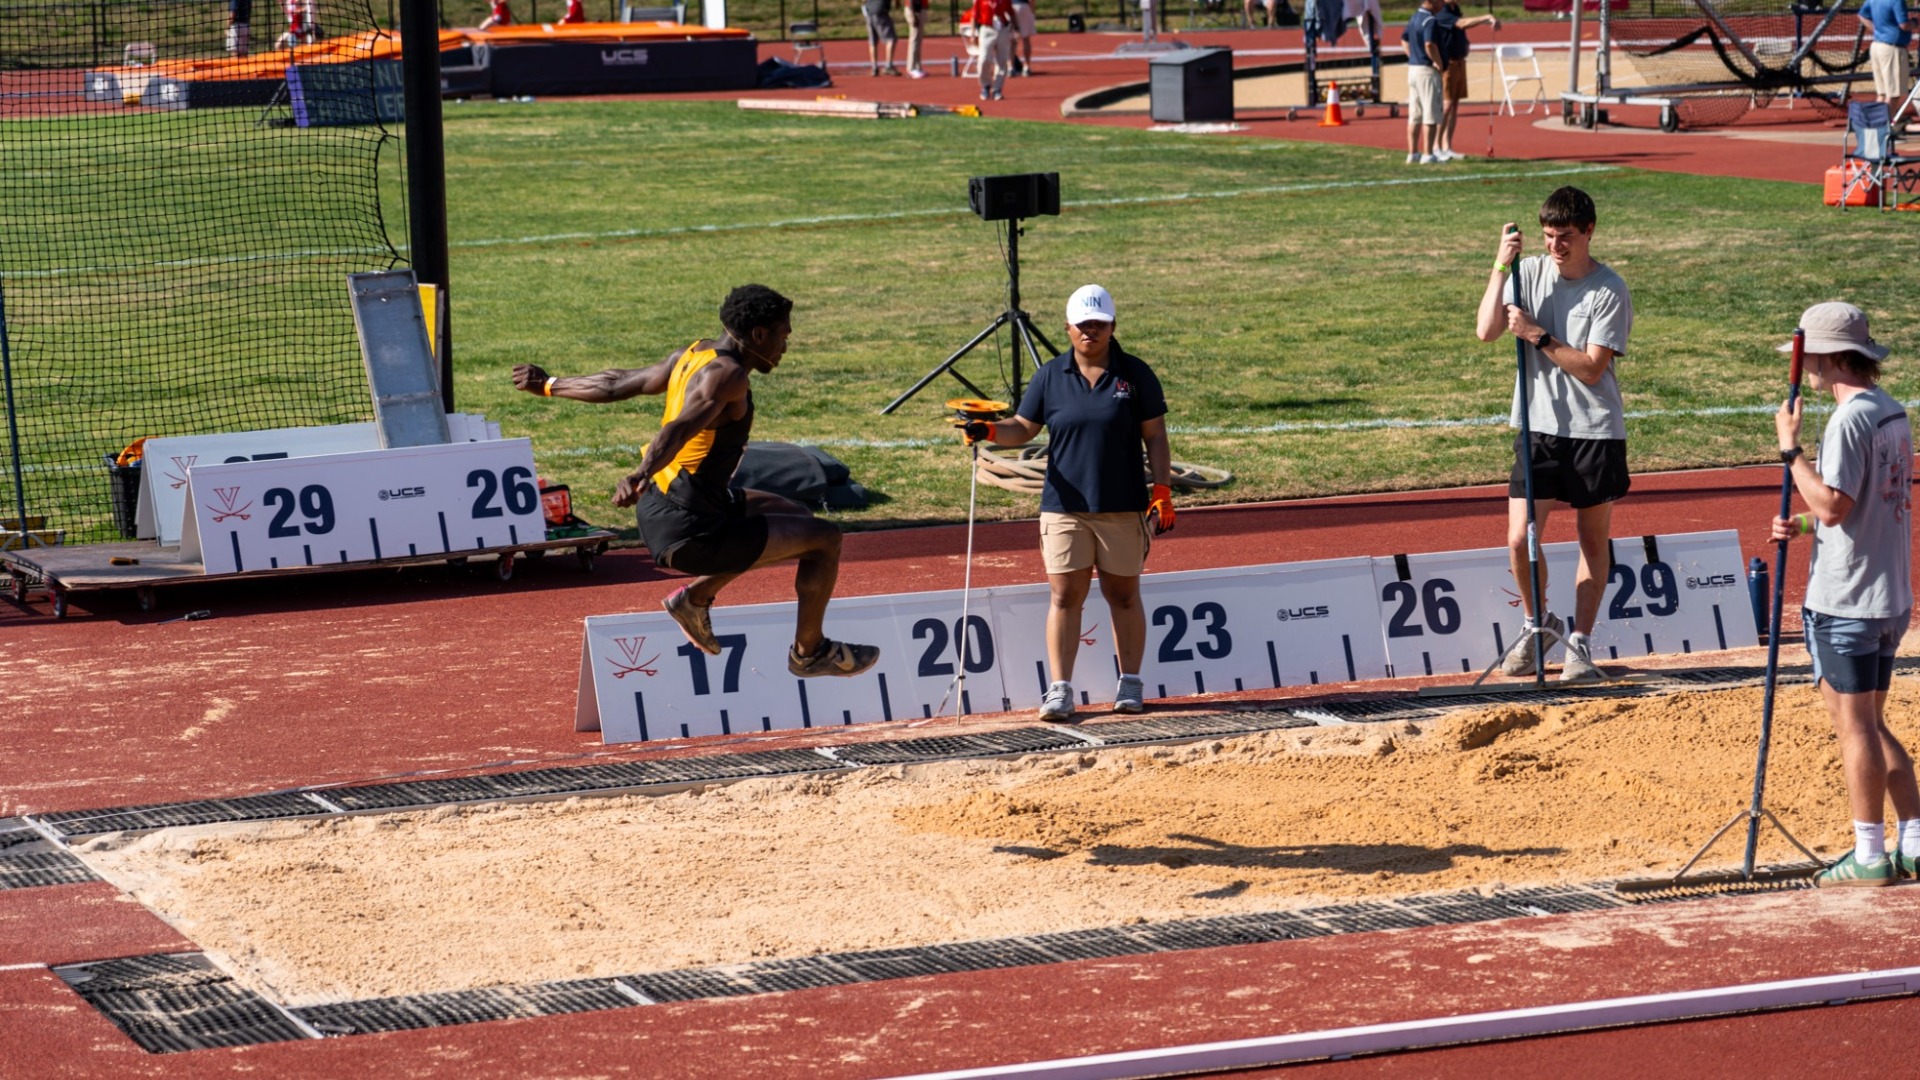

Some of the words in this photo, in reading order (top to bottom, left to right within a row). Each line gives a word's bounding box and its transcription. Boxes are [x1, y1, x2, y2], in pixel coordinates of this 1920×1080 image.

[601, 50, 648, 61] UCS
[263, 484, 336, 539] 29
[389, 486, 426, 497] UCS
[466, 466, 538, 519] 26
[1607, 561, 1679, 620] 29
[1696, 574, 1736, 586] UCS
[1152, 602, 1233, 663] 23
[1288, 605, 1329, 617] UCS
[1382, 578, 1461, 638] 26
[677, 633, 747, 696] 17
[912, 615, 995, 677] 20
